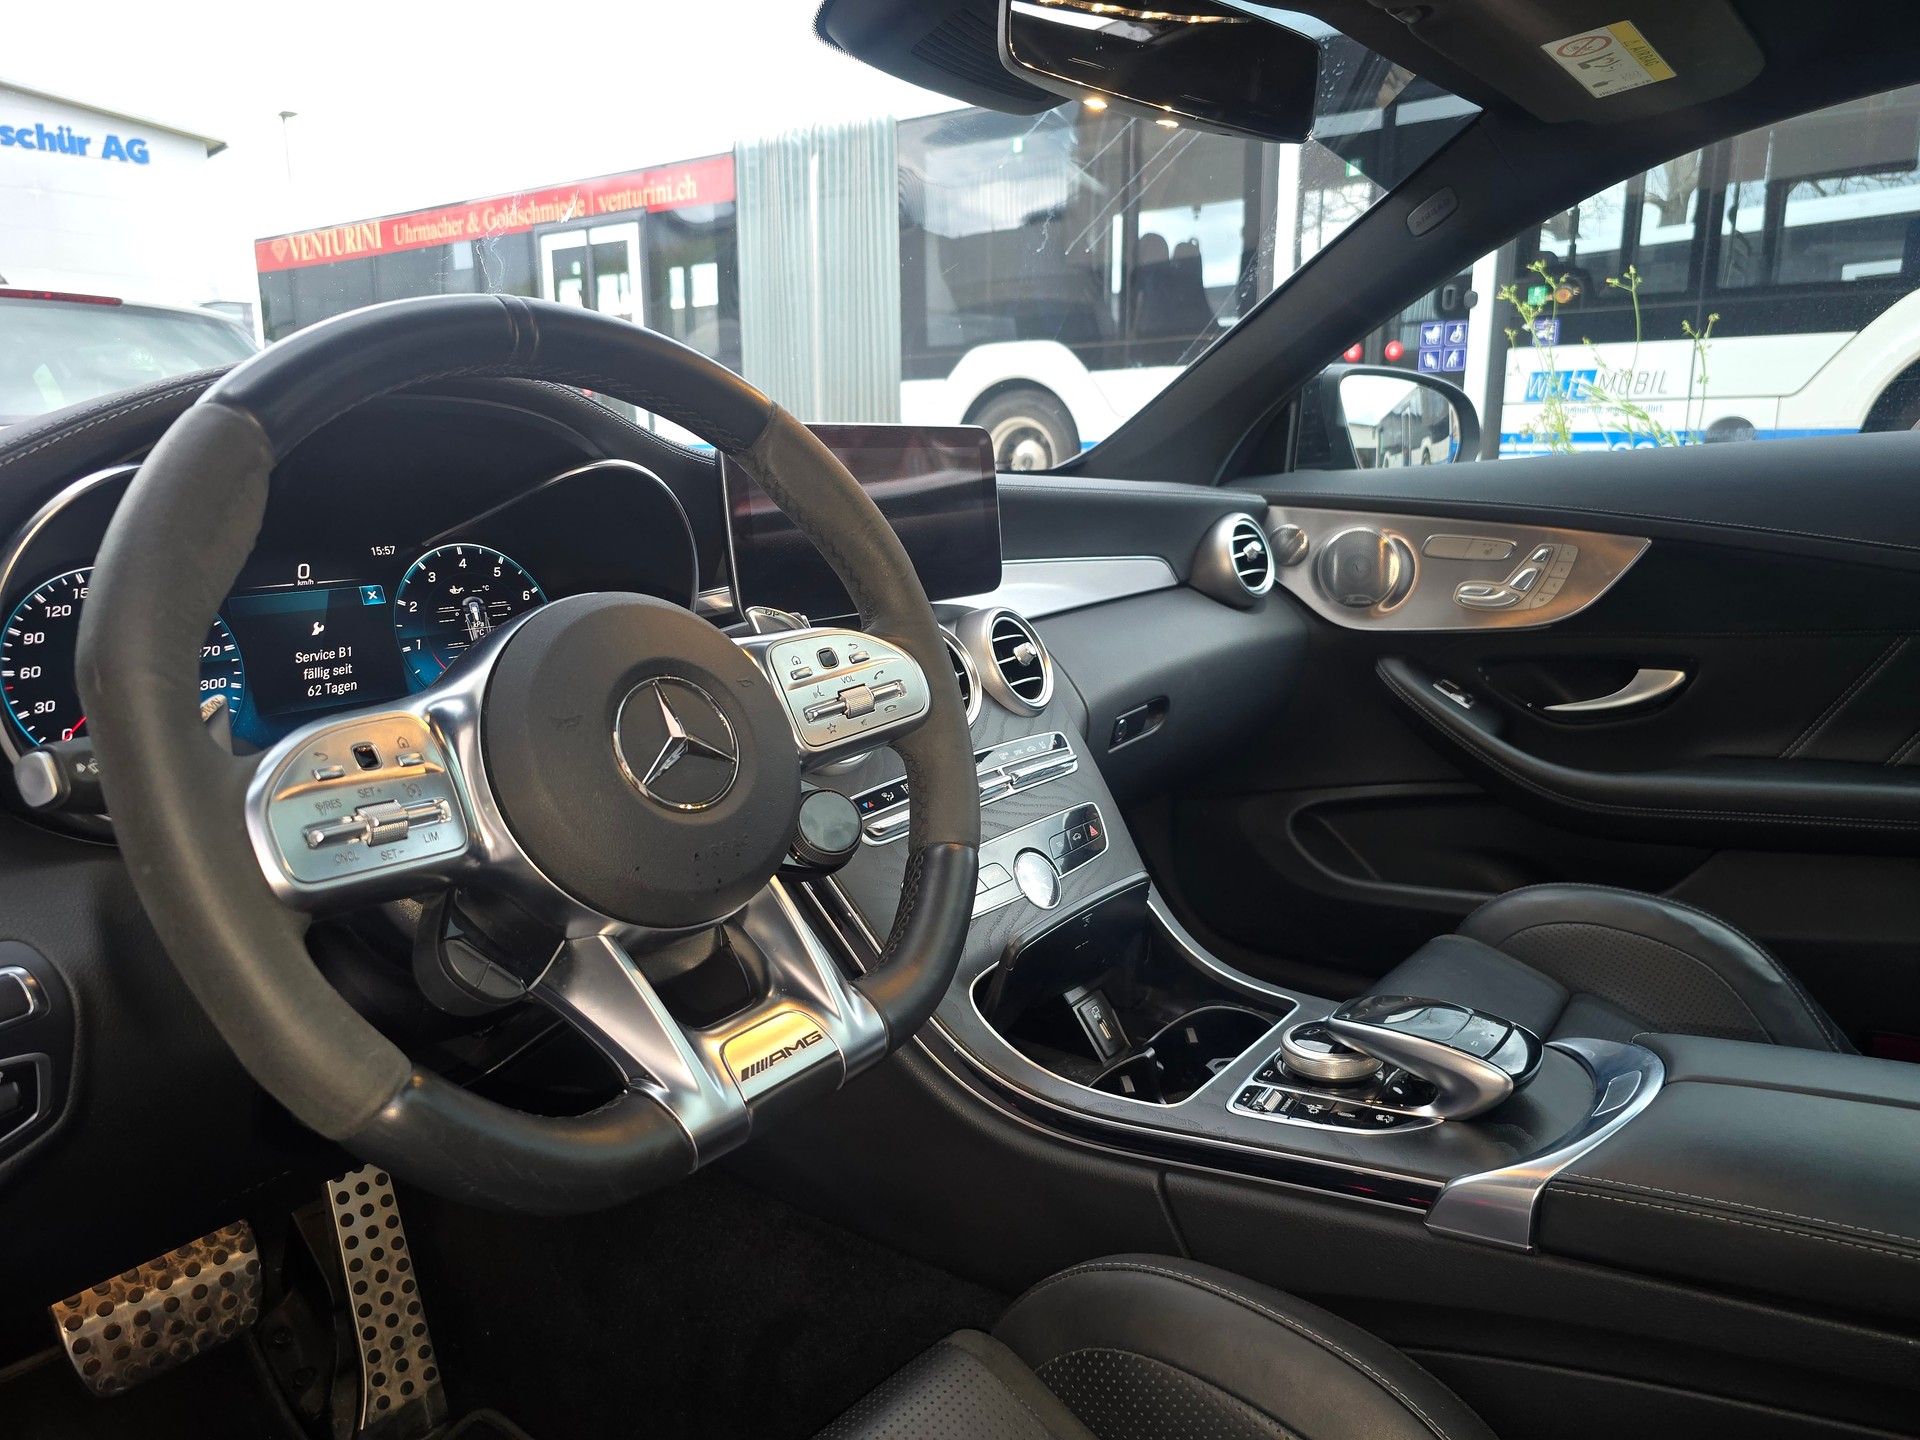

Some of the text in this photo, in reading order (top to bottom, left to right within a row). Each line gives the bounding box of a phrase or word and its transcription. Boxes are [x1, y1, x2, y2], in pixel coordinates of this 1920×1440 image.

[101, 133, 150, 164] AG
[287, 221, 383, 262] VENTURINI
[393, 214, 464, 246] Uhrmacher
[467, 210, 480, 234] &
[482, 194, 586, 231] Goldschmiede
[598, 172, 698, 212] venturini.ch
[371, 545, 396, 556] 15:57
[458, 558, 467, 569] 4
[297, 563, 311, 579] 0
[427, 571, 437, 583] 3
[493, 566, 502, 578] 5
[73, 587, 88, 600] 15
[522, 590, 531, 601] 6
[44, 604, 72, 618] 120
[409, 601, 418, 613] 2
[23, 631, 45, 645] 90
[416, 639, 421, 650] 1
[199, 645, 221, 658] 70
[295, 646, 352, 664] Service B1
[20, 665, 42, 680] 60
[303, 663, 353, 680] fällig seit
[200, 677, 227, 691] 300
[840, 675, 856, 684] VOL
[307, 681, 358, 697] 62 Tagen
[34, 700, 56, 714] 30
[61, 728, 74, 742] 0
[357, 786, 376, 799] SET
[422, 831, 440, 844] LIM
[334, 852, 360, 865] CNCL
[380, 848, 398, 861] SET
